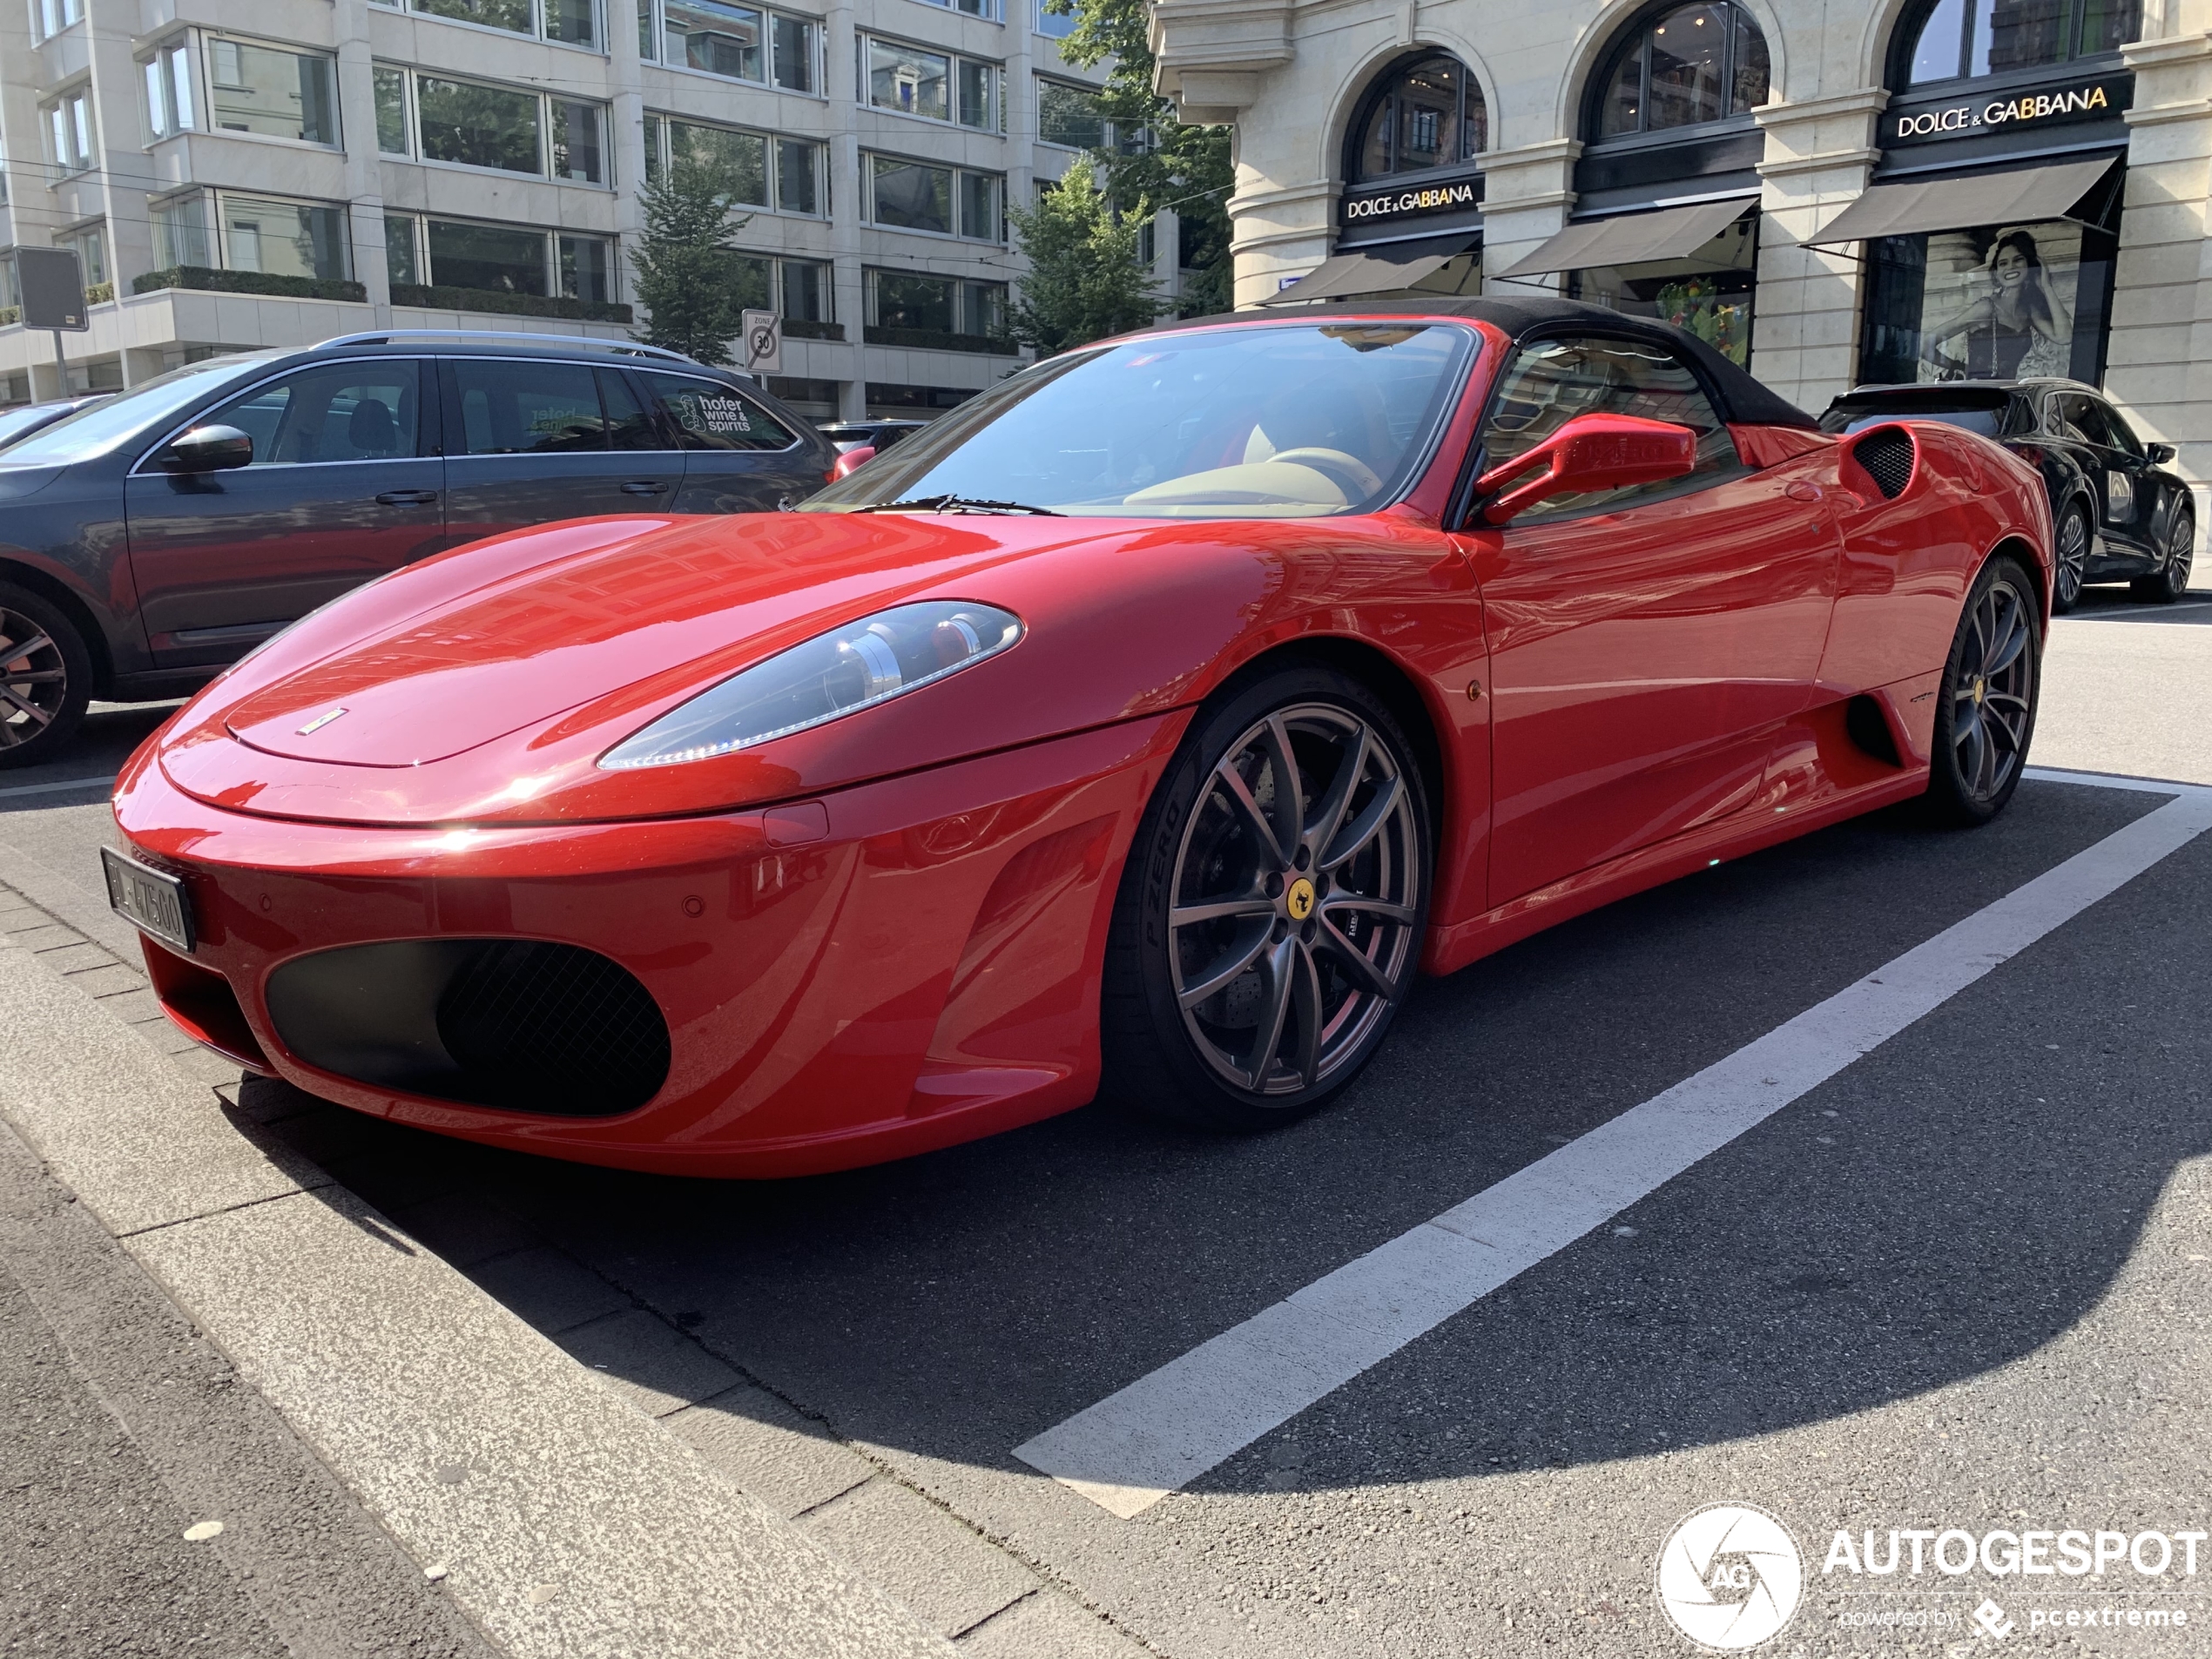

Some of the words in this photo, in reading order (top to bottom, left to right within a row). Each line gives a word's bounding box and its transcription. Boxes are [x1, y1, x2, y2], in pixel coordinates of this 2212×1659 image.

[1898, 107, 1970, 138] DOLCE
[1972, 115, 1981, 125] &
[1983, 87, 2107, 125] GABBANA
[1348, 196, 1392, 218] DOLCE
[1393, 203, 1399, 212] &
[1399, 185, 1474, 211] GABBANA
[754, 316, 771, 325] ZONE
[757, 335, 769, 349] 30
[698, 395, 742, 411] hofer
[703, 410, 737, 421] wine
[738, 412, 748, 421] &
[708, 421, 751, 433] spirits
[1147, 799, 1181, 914] ZERO
